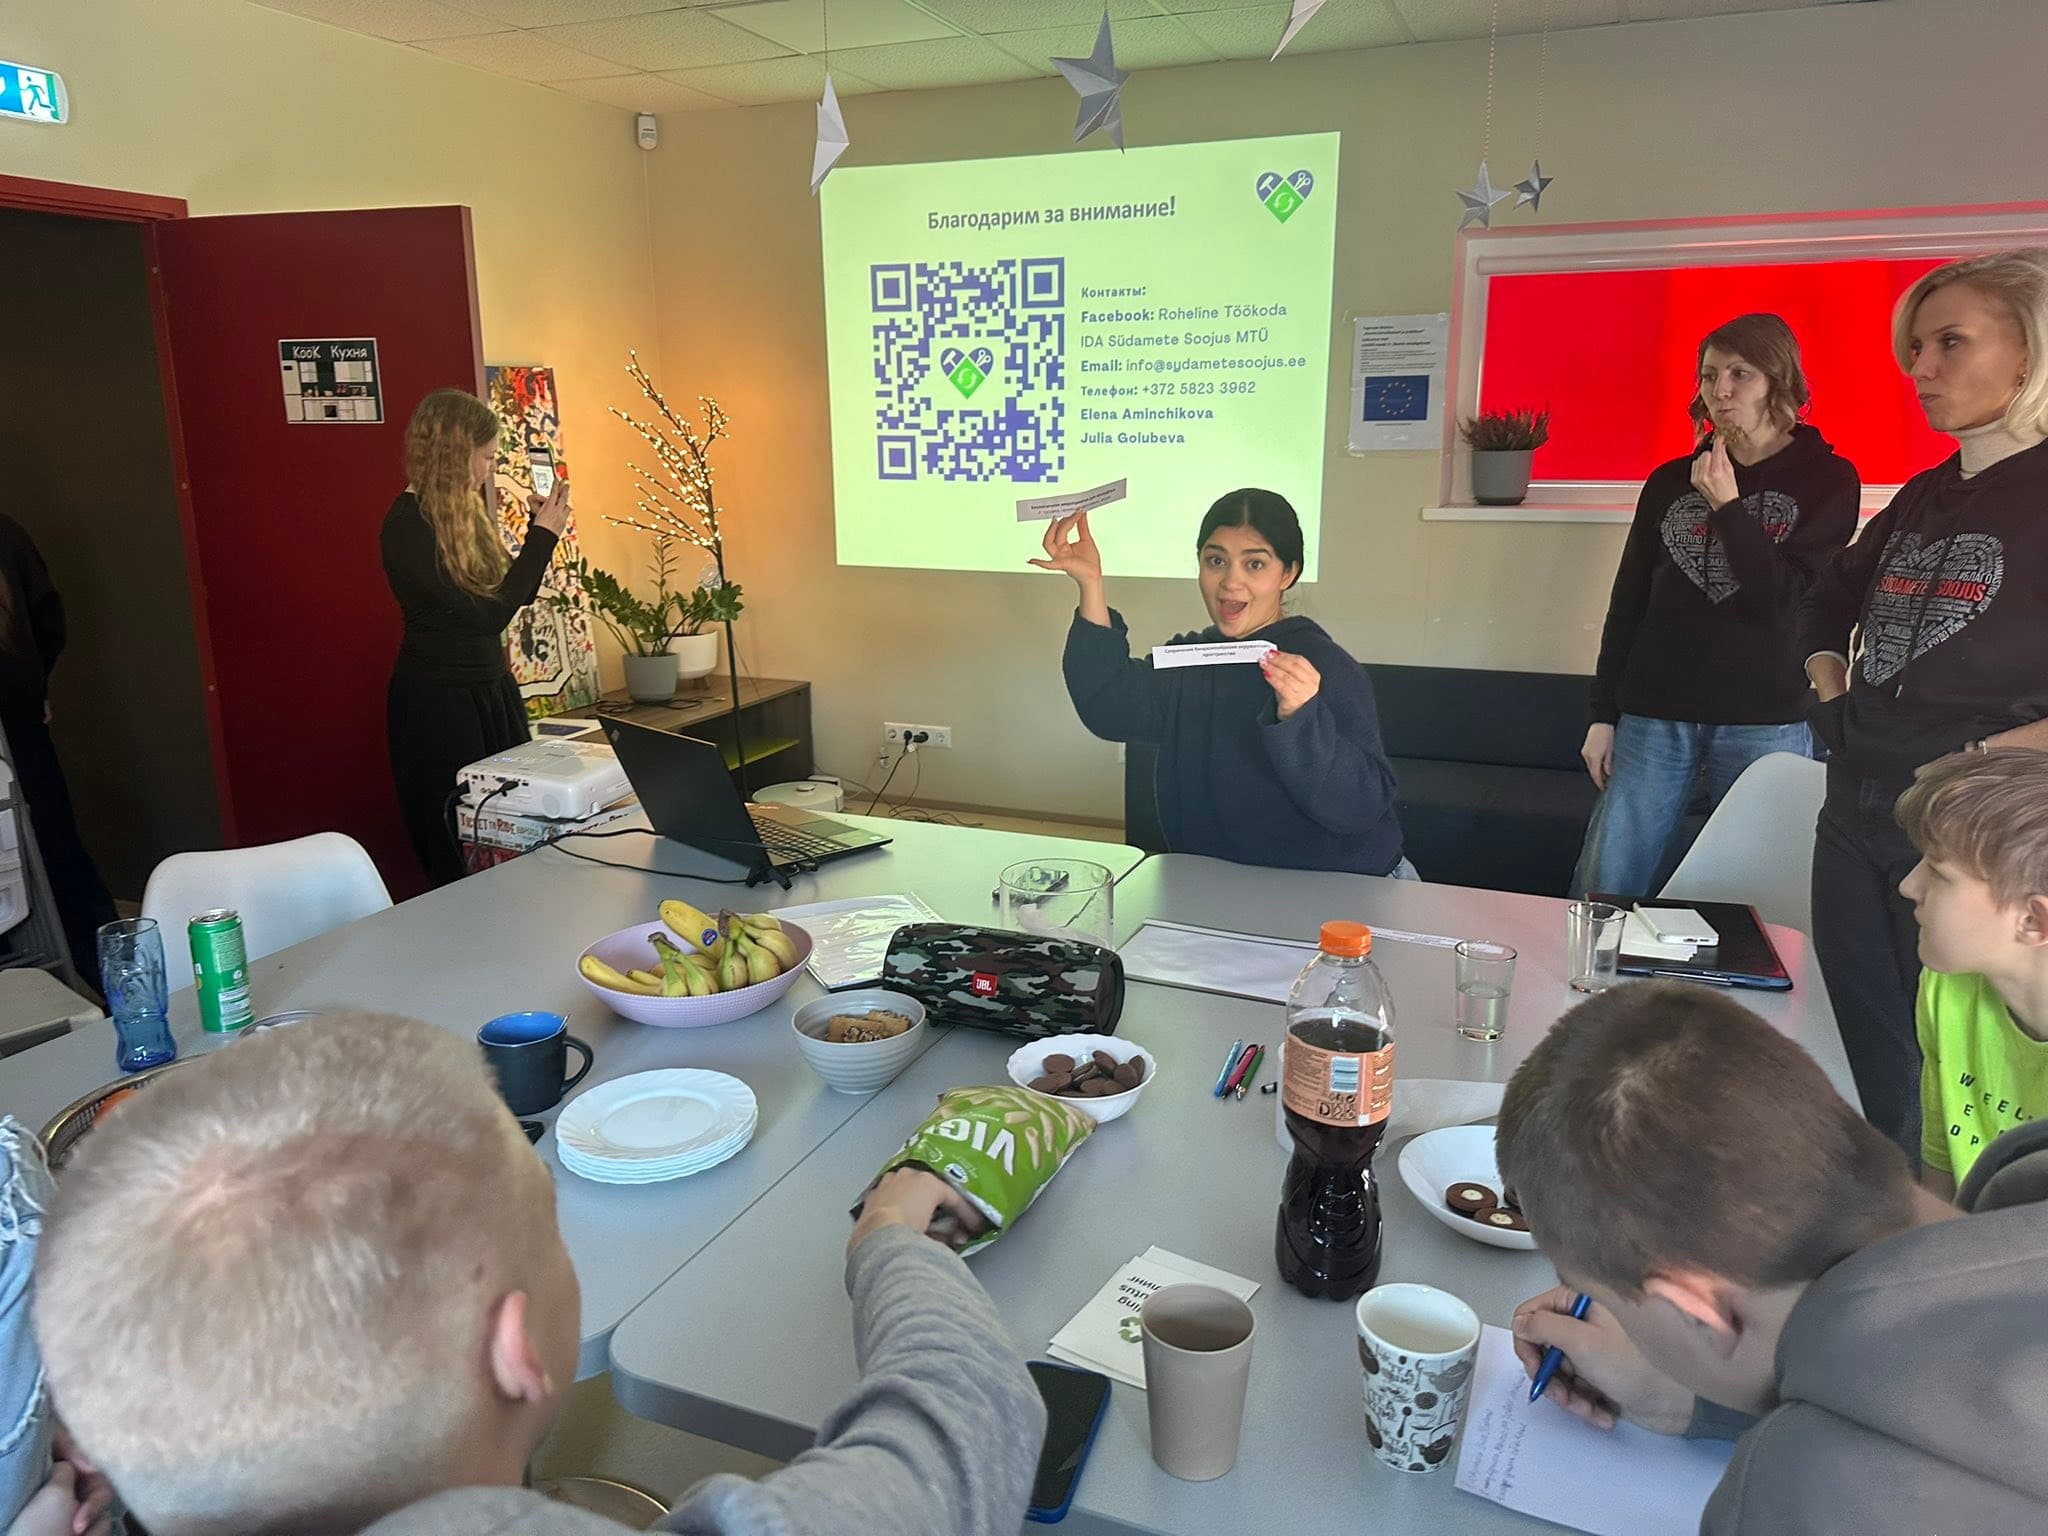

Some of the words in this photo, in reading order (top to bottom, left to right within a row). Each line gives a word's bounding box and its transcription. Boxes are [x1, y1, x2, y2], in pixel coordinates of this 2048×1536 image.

[928, 210, 1040, 231] Благодарим
[1044, 208, 1065, 224] за
[1070, 196, 1176, 222] внимание!
[1081, 286, 1146, 298] Контакты:
[1081, 308, 1154, 323] Facebook:
[1158, 307, 1219, 321] Roheline
[1224, 303, 1287, 318] Töökoda
[1081, 335, 1104, 348] IDA
[1108, 334, 1179, 347] Südamete
[1184, 331, 1231, 347] Soojus
[1236, 328, 1269, 343] MTÜ
[330, 345, 368, 361] Кухня
[1081, 359, 1122, 372] Email:
[1126, 355, 1306, 374] info@sydametesoojus.ee
[1081, 385, 1138, 398] Телефон:
[1142, 382, 1175, 395] +372
[1179, 382, 1215, 395] 5823
[1080, 408, 1118, 420] Elena
[1122, 407, 1214, 420] Aminchikova
[1080, 432, 1113, 444] Julia
[1117, 432, 1185, 444] Golubeva
[1936, 580, 1987, 602] SOOJUS
[976, 978, 992, 991] JBL
